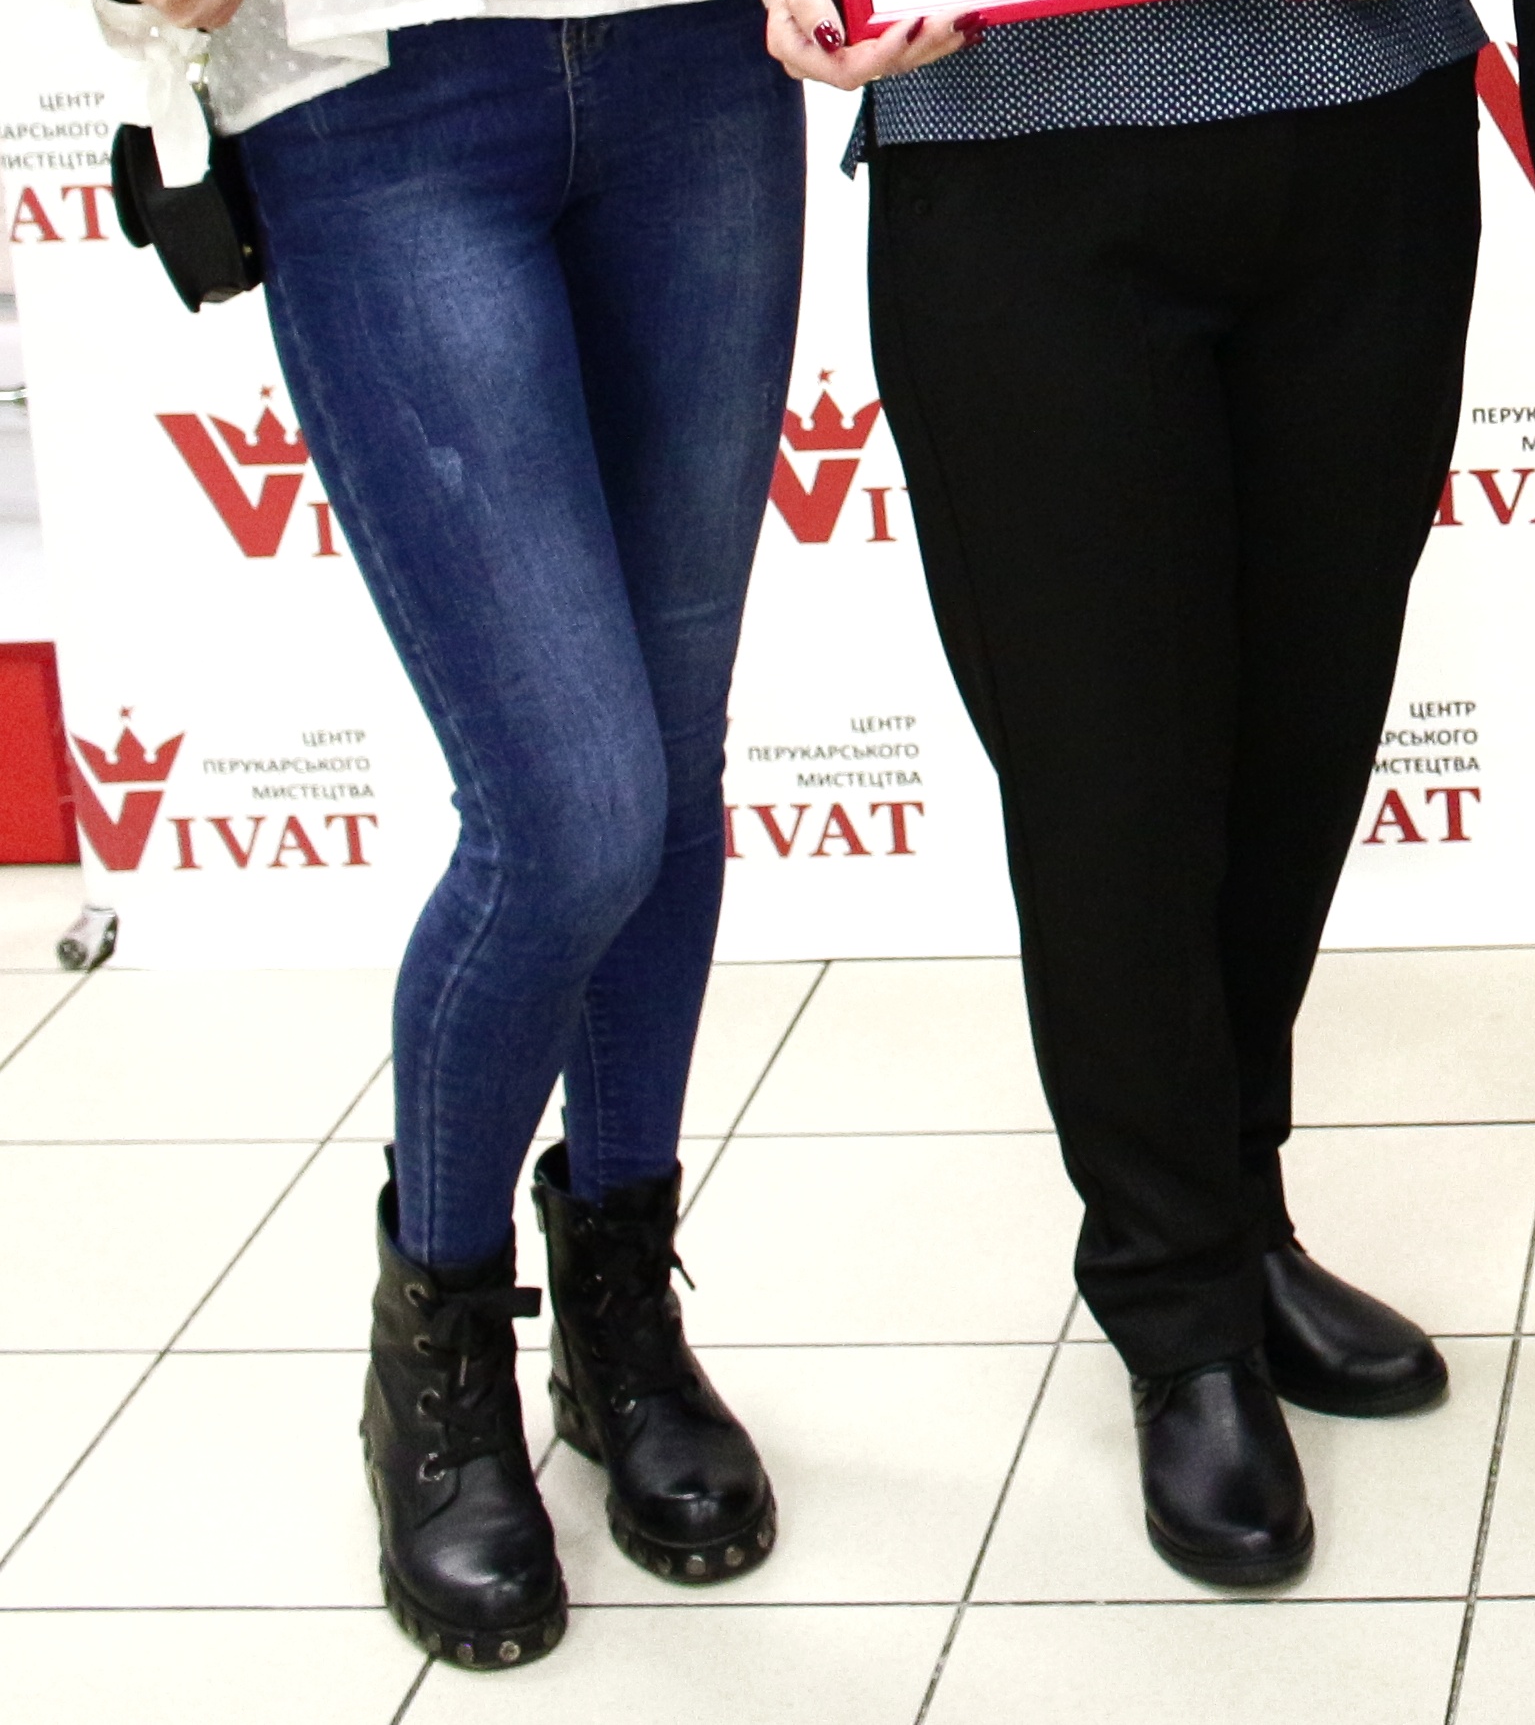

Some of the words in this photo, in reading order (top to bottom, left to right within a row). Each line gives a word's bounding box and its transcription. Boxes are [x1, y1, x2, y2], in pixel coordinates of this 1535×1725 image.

[39, 91, 105, 112] ЦЕНТР
[0, 121, 108, 144] АРСЬКОГО
[1409, 700, 1477, 721] ЦЕНТР
[850, 715, 917, 735] ЦЕНТР
[302, 729, 366, 748] ЦЕНТР
[1377, 728, 1480, 749] РСЬКОГО
[747, 743, 920, 762] ПЕРУКАРСЬКОГО
[202, 755, 371, 774] ПЕРУКАРСЬКОГО
[1372, 756, 1482, 777] ИСТЕЦТВА
[796, 769, 923, 789] МИСТЕЦТВА
[68, 724, 378, 872] VIVAT
[251, 783, 375, 801] МИСТЕЦТВА
[724, 800, 925, 859] IVAT
